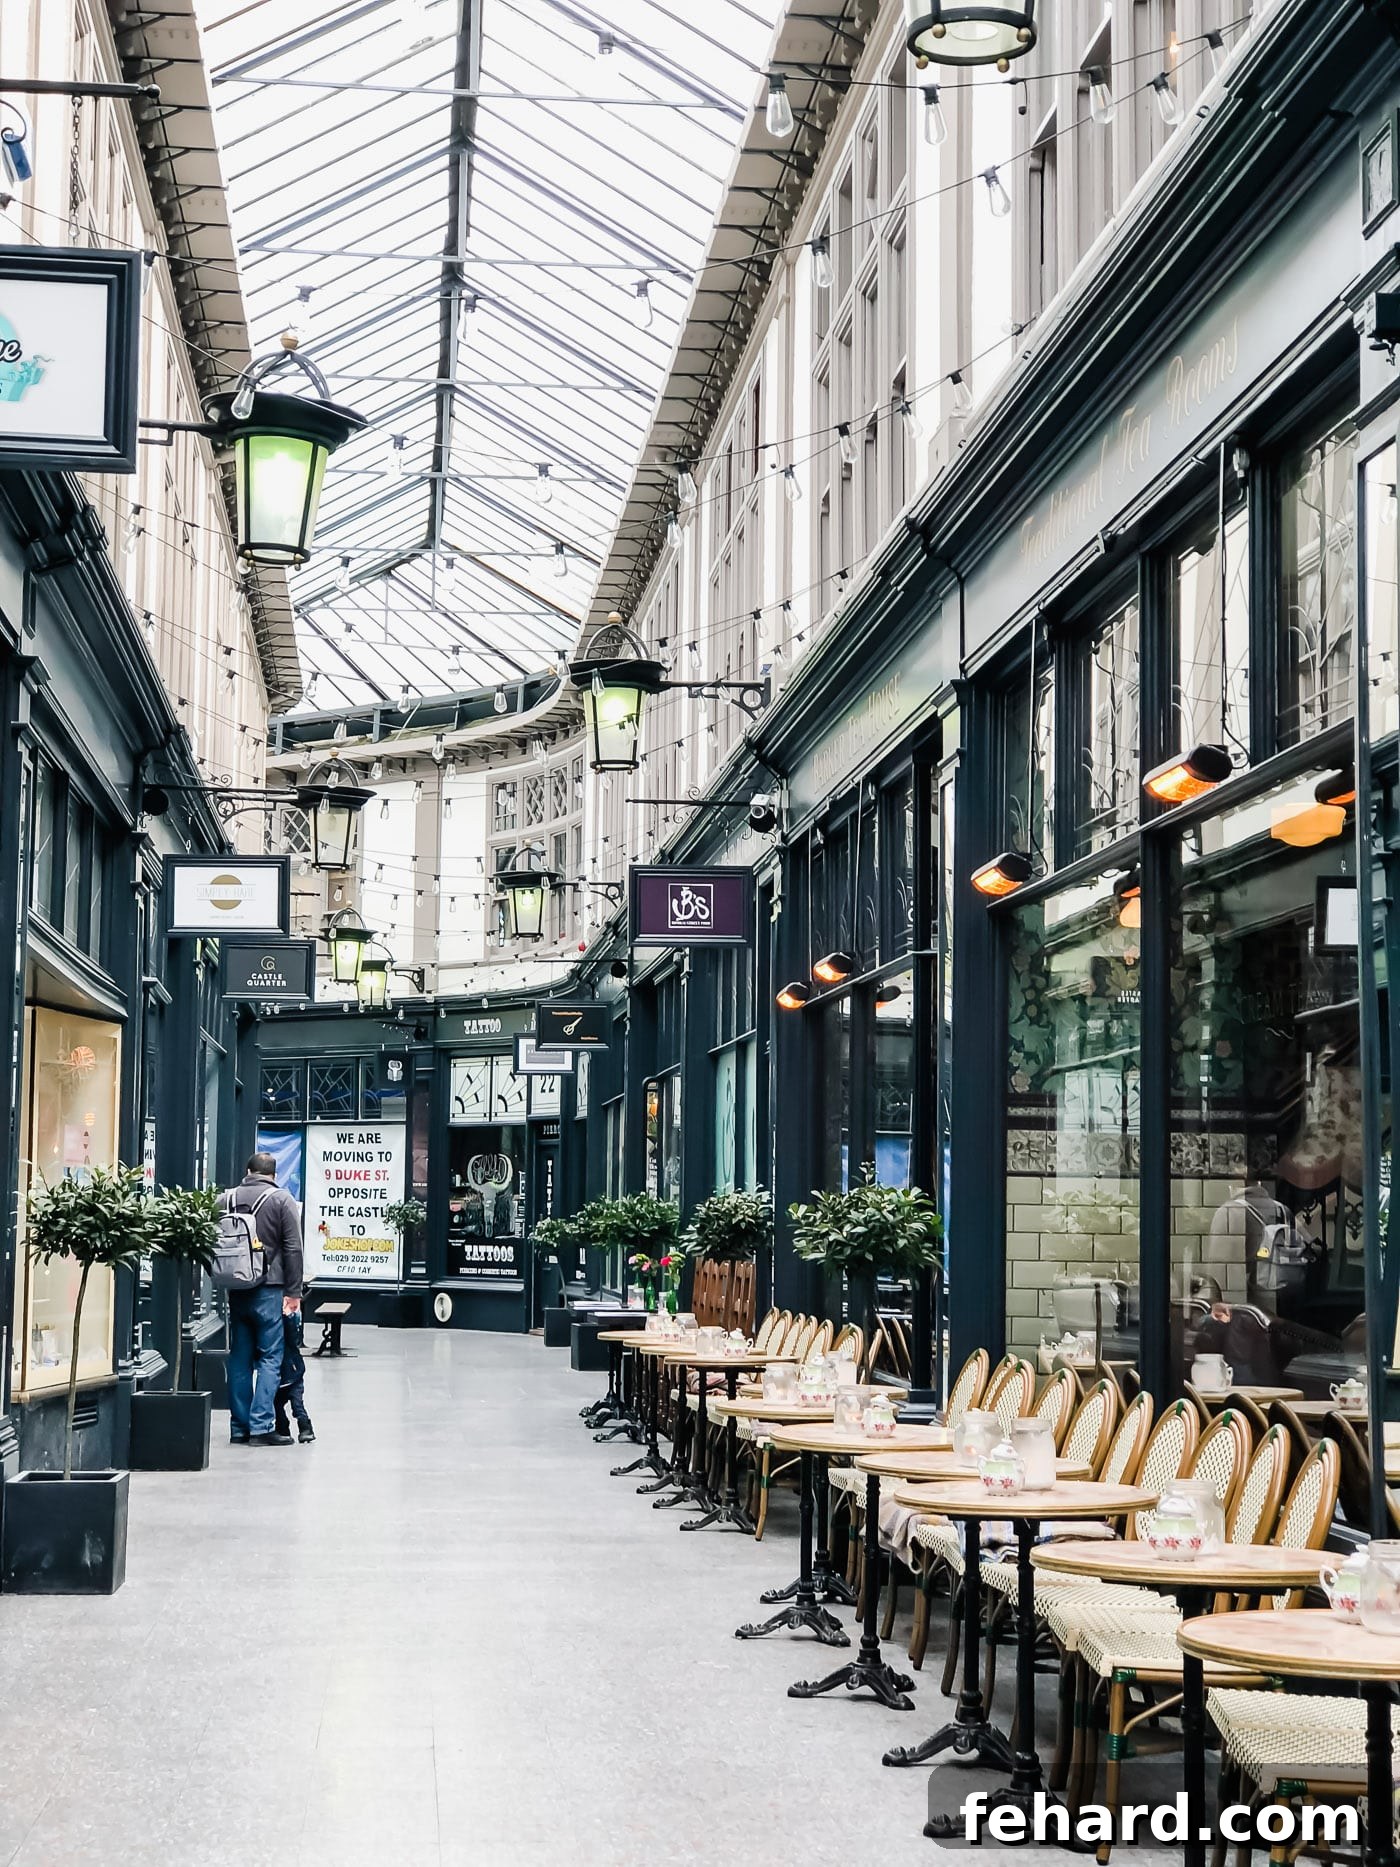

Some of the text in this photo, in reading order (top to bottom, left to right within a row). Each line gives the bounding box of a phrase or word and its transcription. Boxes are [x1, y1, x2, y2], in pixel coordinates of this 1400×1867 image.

[1116, 405, 1151, 484] Tea
[1163, 316, 1240, 436] Rooms
[464, 1018, 501, 1034] TATTOO
[540, 1075, 554, 1093] 22
[336, 1133, 381, 1144] WE ARE
[322, 1151, 393, 1162] MOVING TO
[325, 1169, 389, 1181] 9 DUKE ST.
[328, 1188, 387, 1200] OPPOSITE
[320, 1206, 389, 1218] THE CASTL
[349, 1225, 366, 1236] TO
[322, 1254, 389, 1264] Tel:029 2022 9257
[464, 1245, 514, 1262] TATTOOS
[358, 1266, 372, 1274] 1AY
